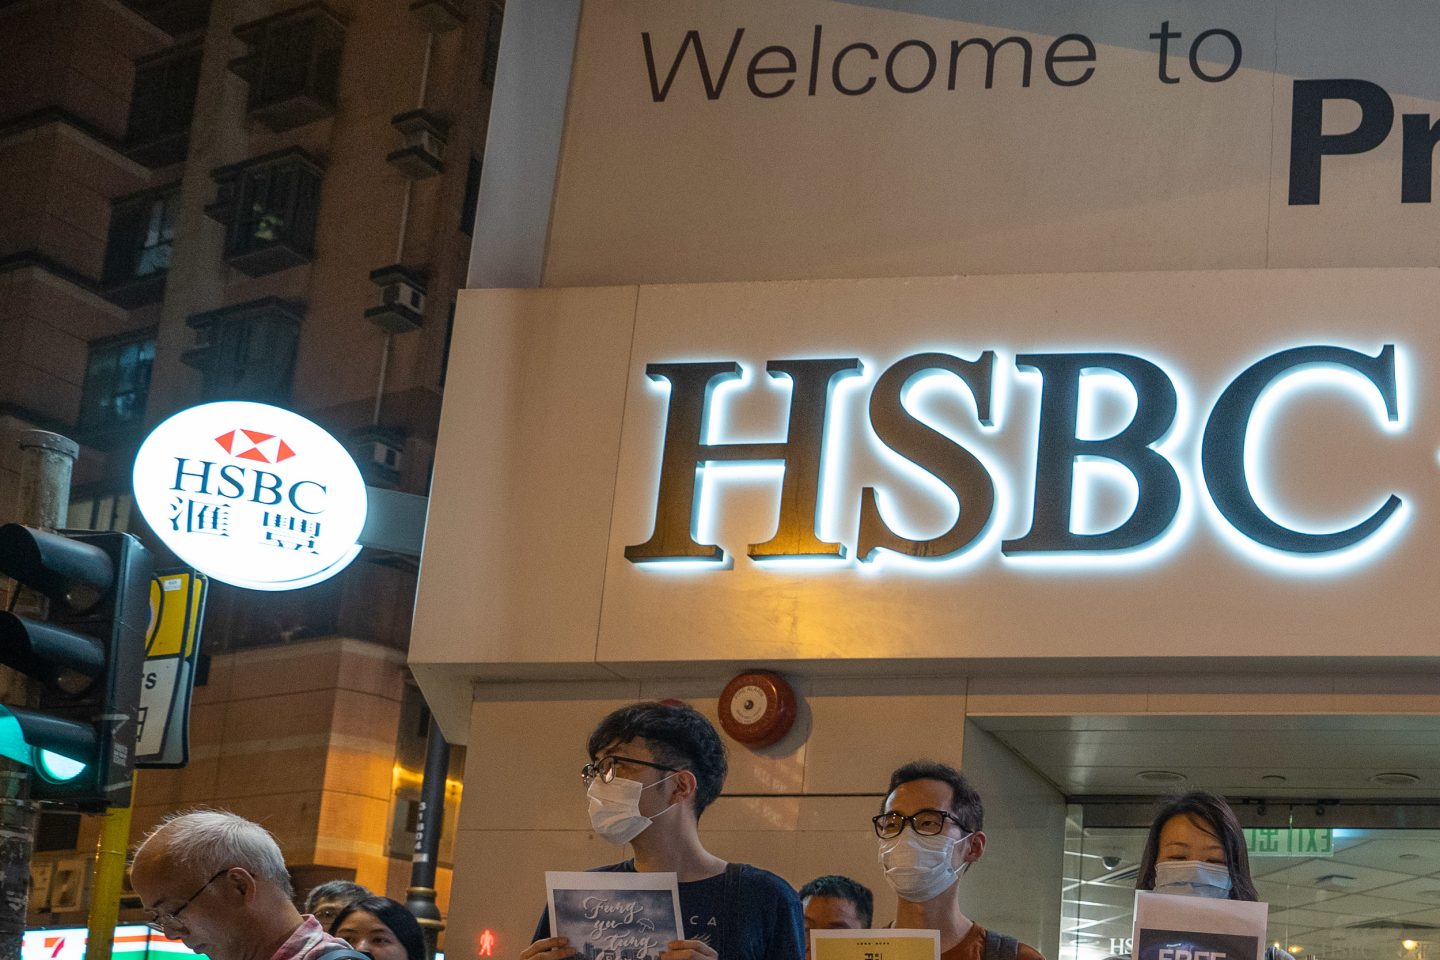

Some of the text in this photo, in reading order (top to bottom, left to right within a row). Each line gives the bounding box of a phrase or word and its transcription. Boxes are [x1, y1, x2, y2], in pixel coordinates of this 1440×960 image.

[641, 20, 1242, 103] Welcome to
[624, 343, 1402, 566] HSBC
[169, 456, 327, 515] HSBC
[583, 896, 644, 923] Fung
[1109, 937, 1133, 955] HS
